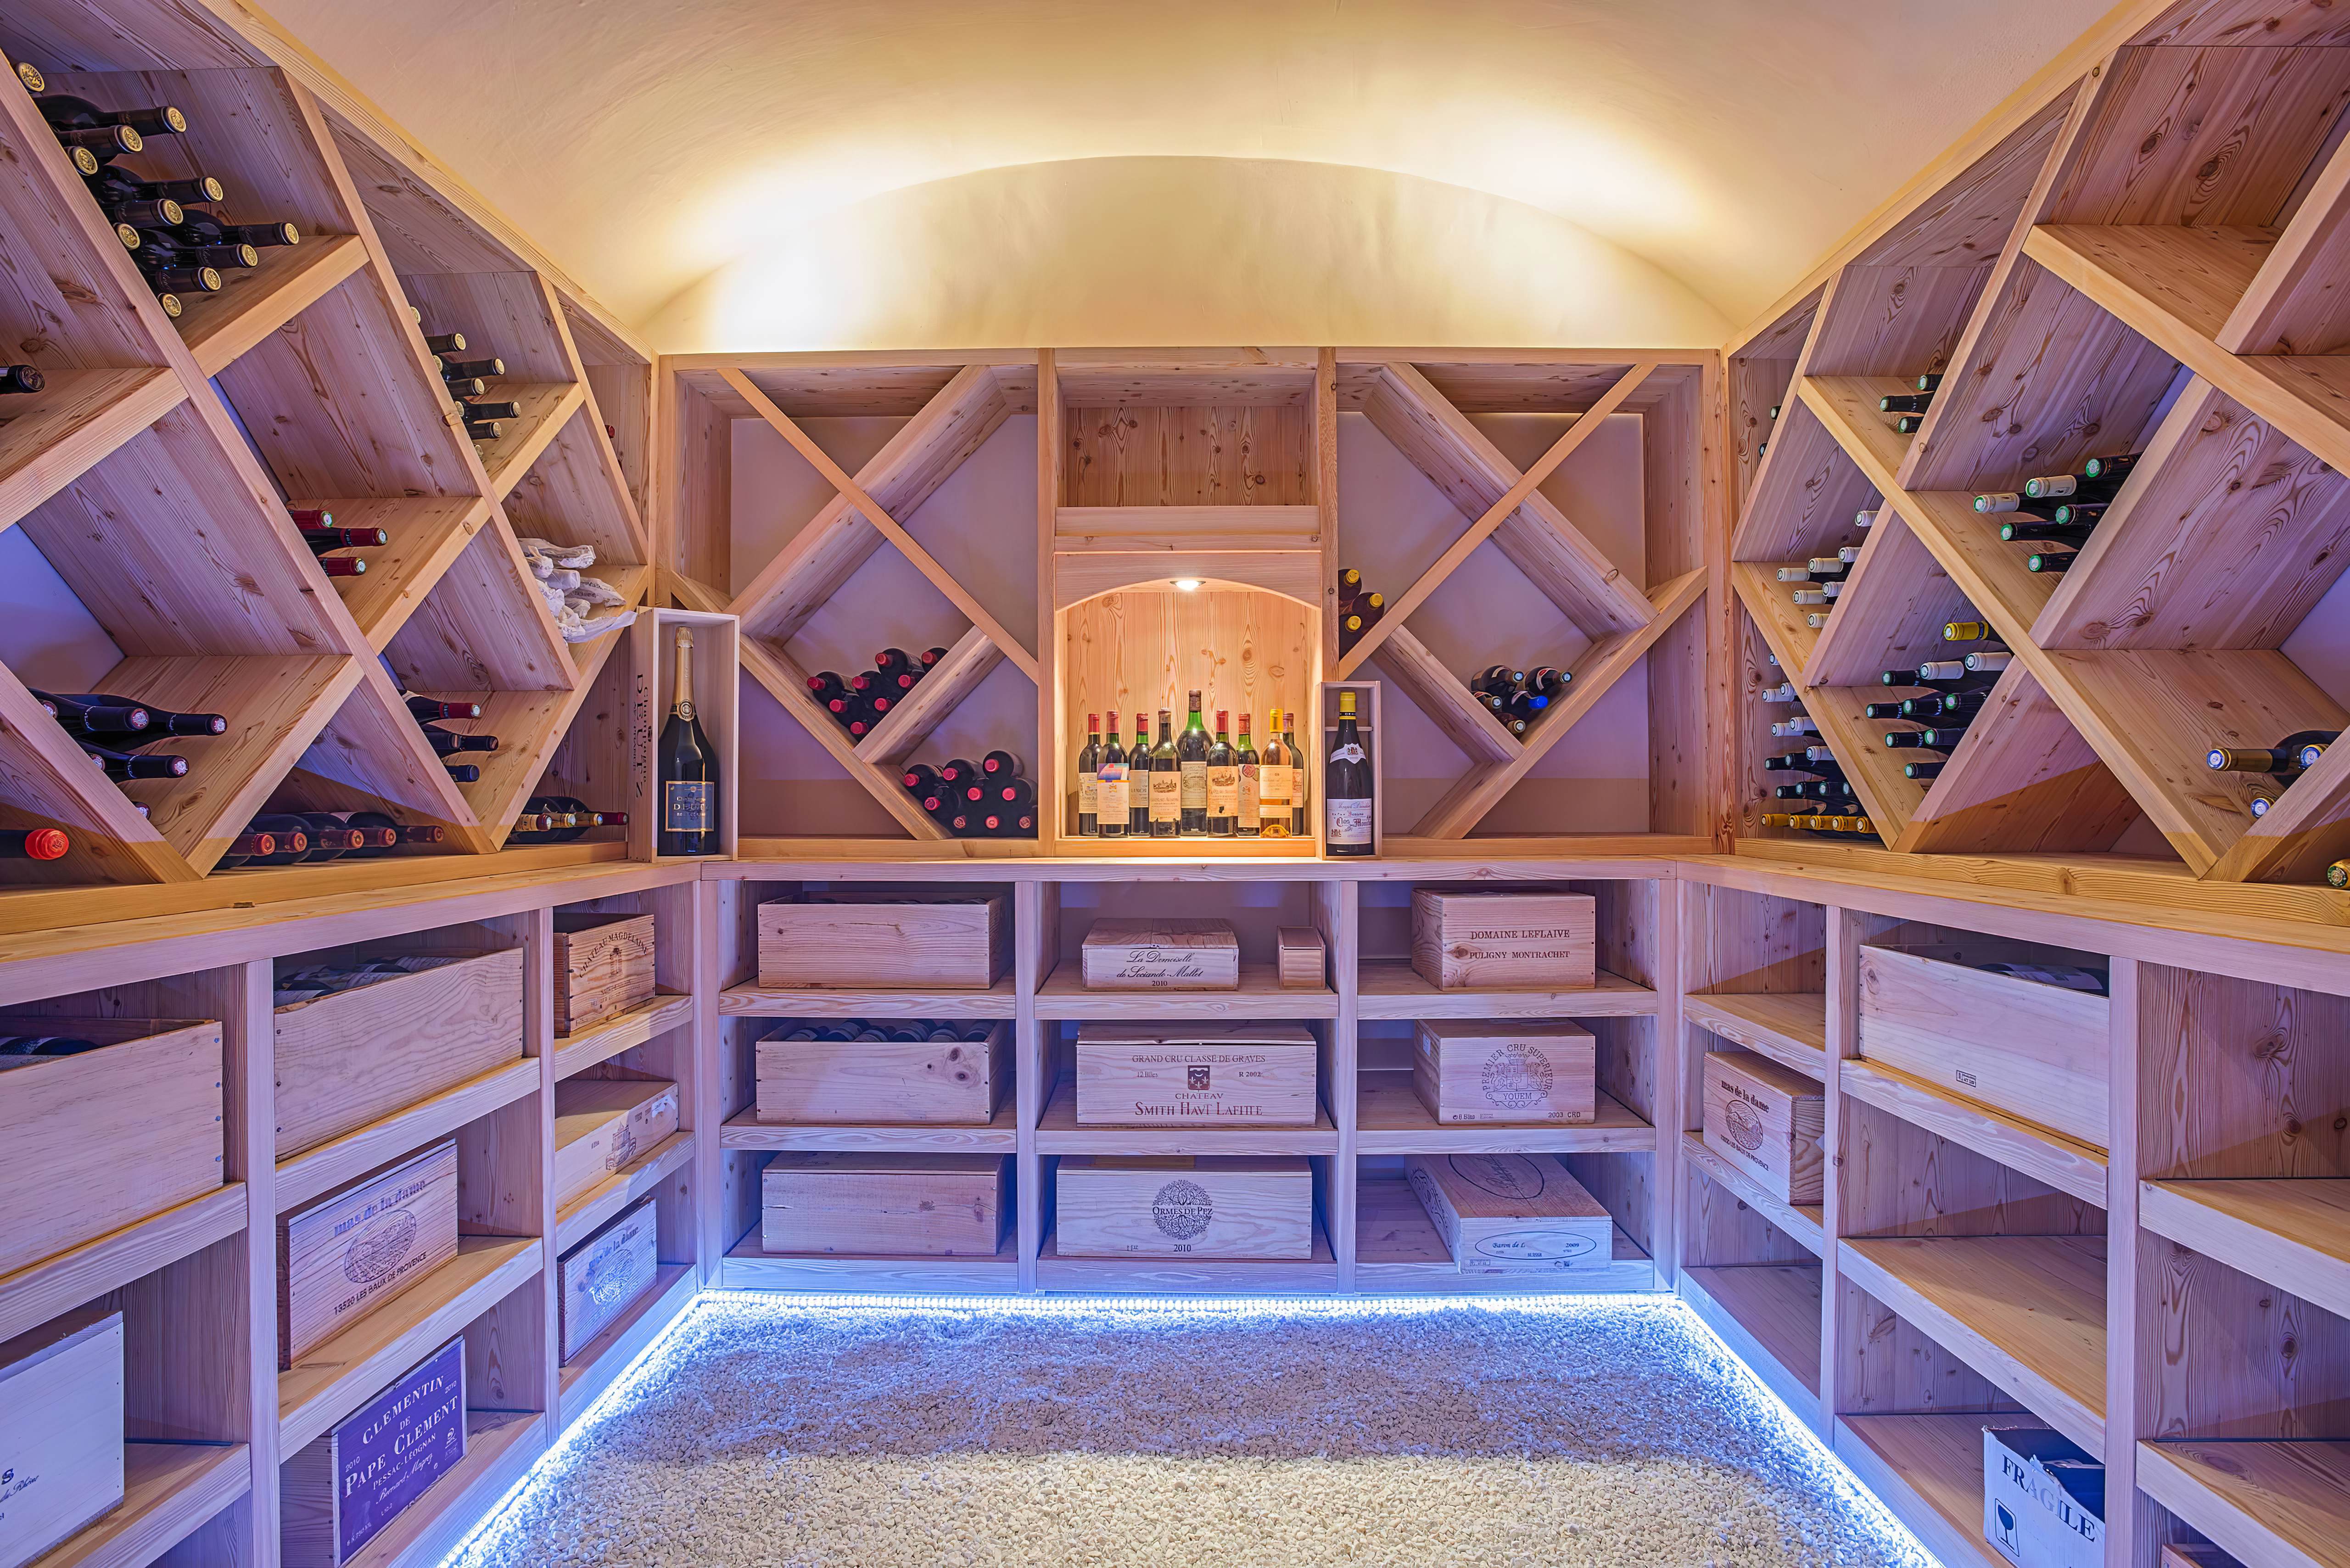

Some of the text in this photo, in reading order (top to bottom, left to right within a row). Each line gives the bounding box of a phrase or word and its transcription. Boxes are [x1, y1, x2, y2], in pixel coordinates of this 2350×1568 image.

[1471, 930, 1570, 940] DOMAINE LEFLAIVE
[1126, 951, 1145, 962] La
[1117, 969, 1127, 977] de
[1482, 1044, 1553, 1091] PREMIER CRU SUPERIEUR
[1735, 1086, 1742, 1098] de
[1743, 1089, 1749, 1102] la
[1751, 1094, 1769, 1113] dame
[1152, 1206, 1183, 1215] ORMES
[1197, 1206, 1213, 1215] PEZ
[334, 1251, 427, 1315] 13520 LES BAUX DE PROVENCE
[363, 1375, 444, 1444] CLEMENTIN
[400, 1416, 410, 1430] DE
[345, 1453, 386, 1498] PAPE
[394, 1395, 458, 1455] CLEMENT
[345, 1456, 360, 1473] 2010
[373, 1433, 436, 1490] PESSAC-LEOGNAN
[2002, 1454, 2095, 1543] FRAGILE
